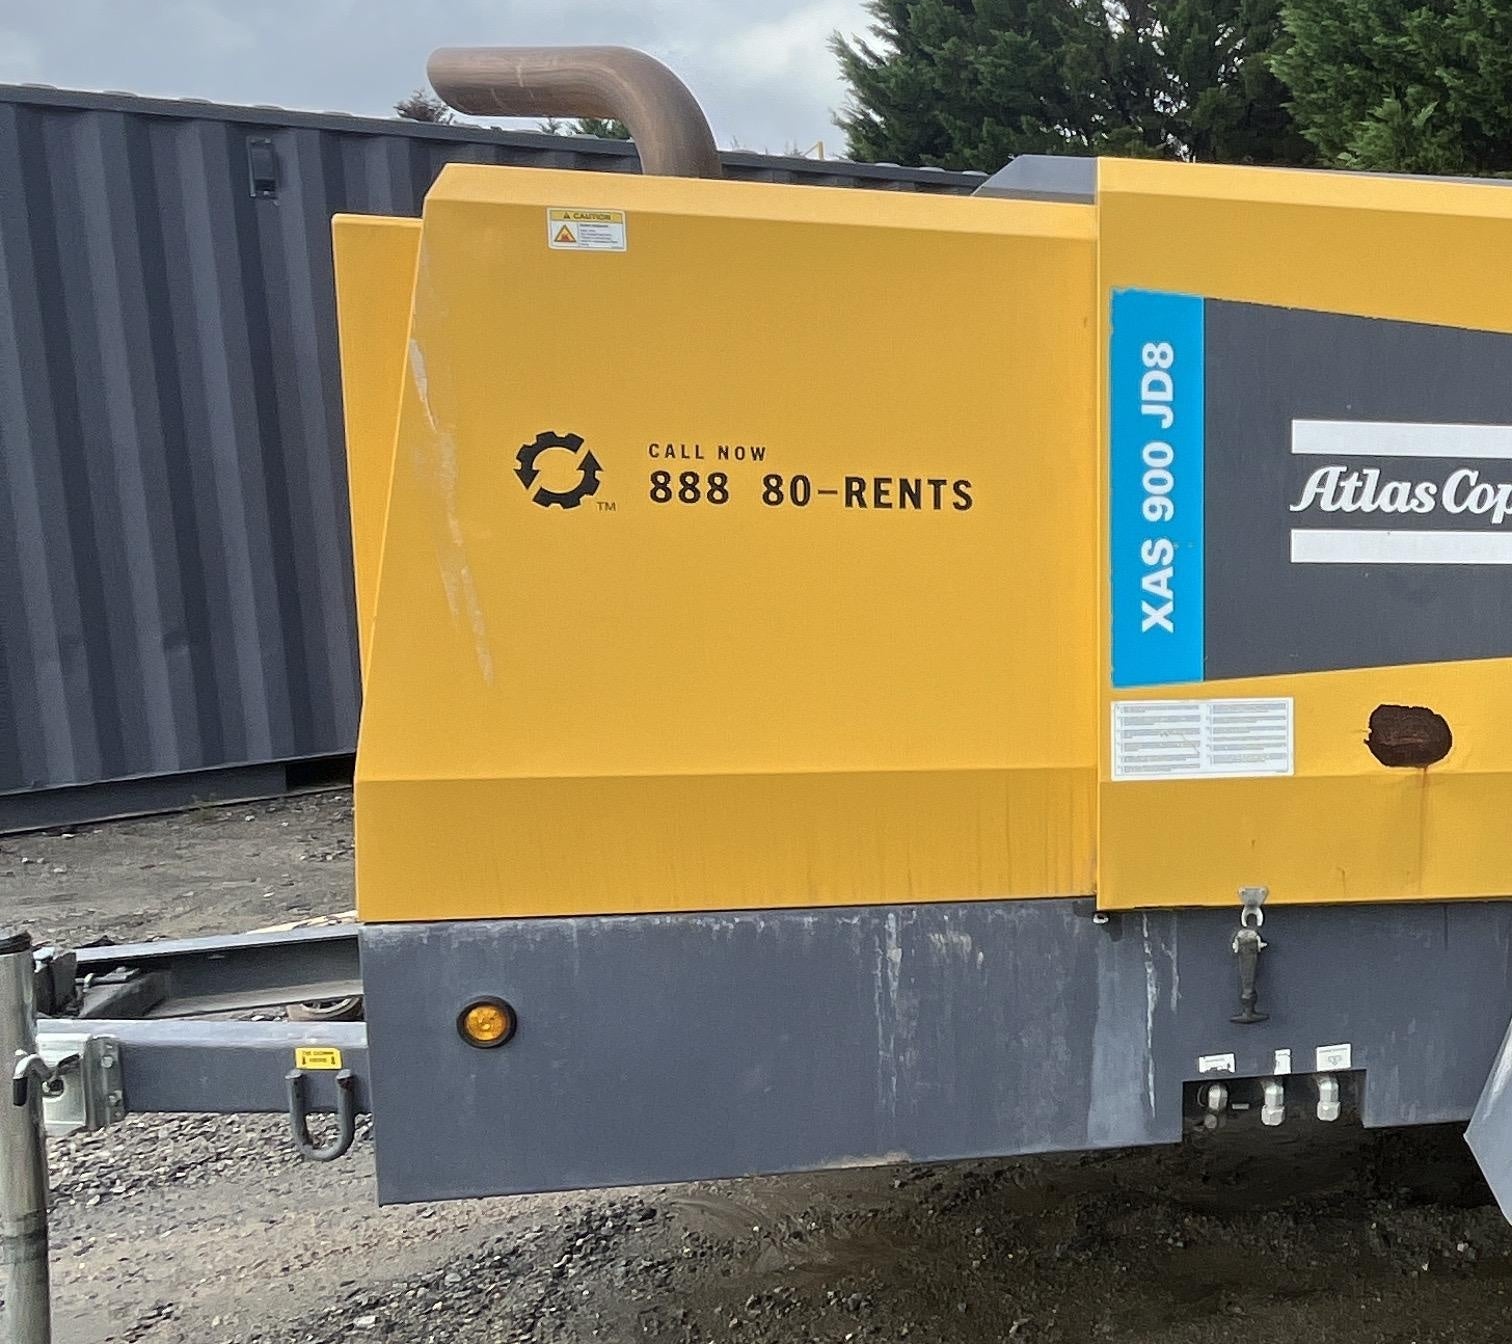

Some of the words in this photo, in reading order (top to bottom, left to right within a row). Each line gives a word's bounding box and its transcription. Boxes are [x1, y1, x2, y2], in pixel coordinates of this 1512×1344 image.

[1141, 342, 1175, 429] JD8
[648, 442, 705, 460] CALL
[717, 444, 767, 462] NOW
[1141, 441, 1175, 523] 900
[649, 470, 730, 505] 888
[762, 473, 974, 511] 80-RENTS
[1290, 465, 1438, 514] Atlas
[1141, 537, 1175, 633] XAS
